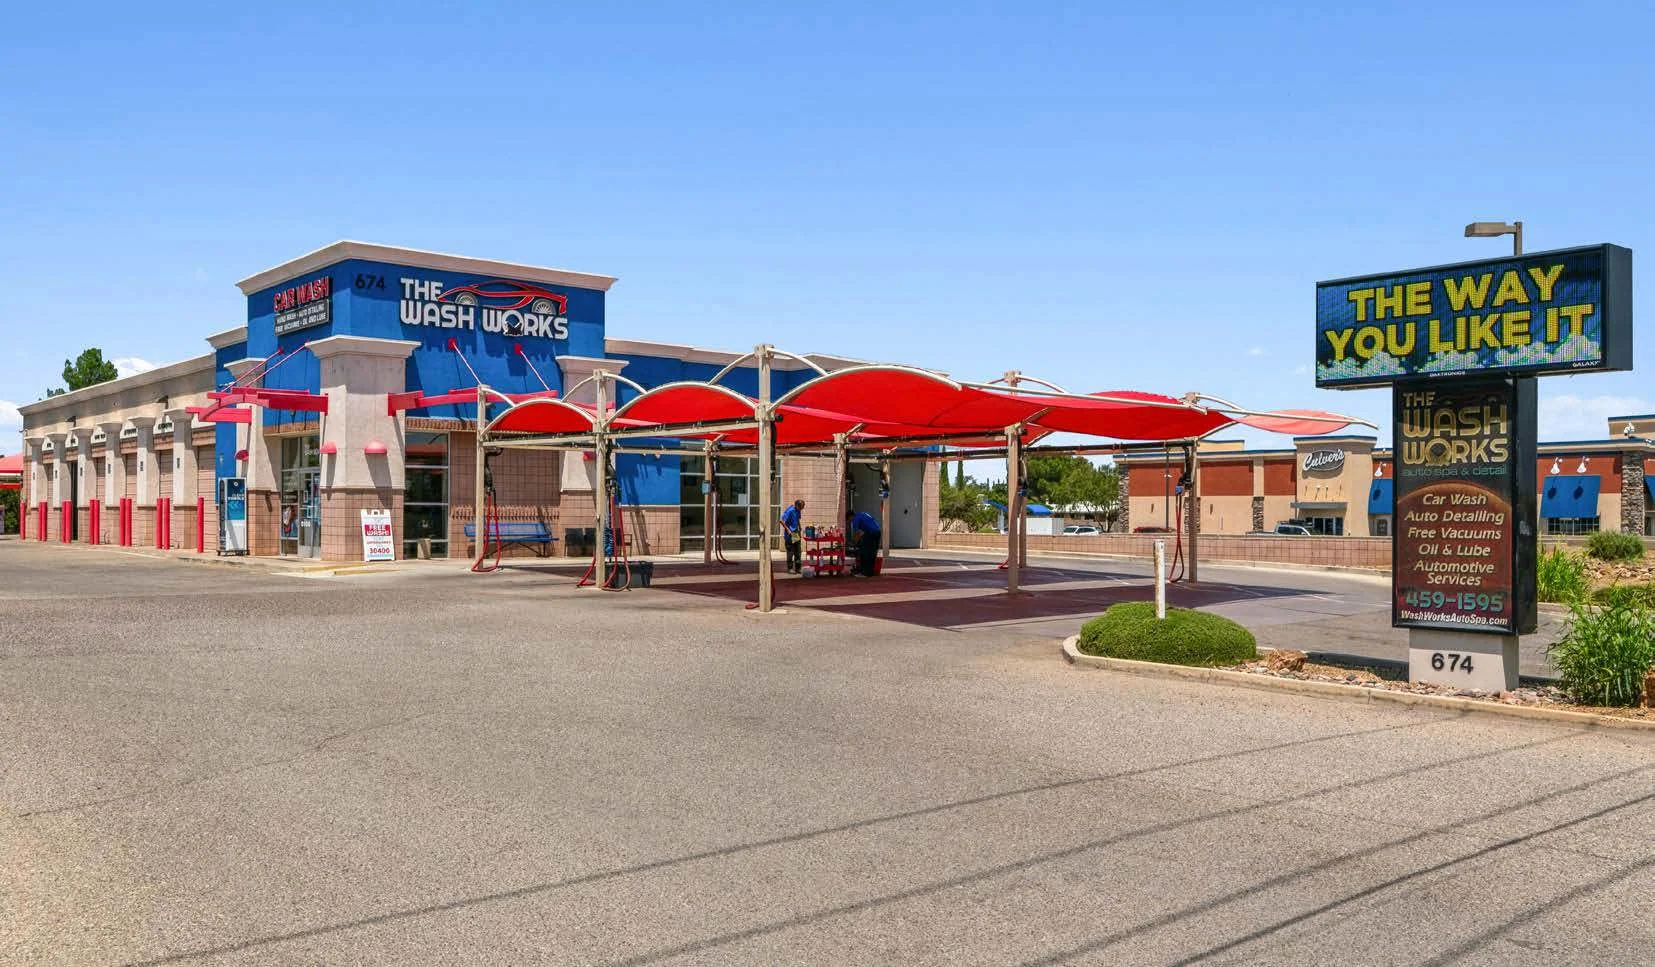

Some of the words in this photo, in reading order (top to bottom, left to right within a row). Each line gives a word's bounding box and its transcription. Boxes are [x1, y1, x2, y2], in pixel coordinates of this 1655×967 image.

[355, 273, 385, 290] 674
[400, 277, 443, 301] THE
[274, 288, 295, 312] CAR
[296, 276, 329, 304] WASH
[1348, 281, 1432, 322] THE
[1443, 264, 1565, 312] WAY
[400, 299, 475, 331] WASH
[482, 308, 569, 340] WORKS
[1325, 322, 1416, 361] YOU
[1429, 310, 1531, 353] LIKE
[1546, 303, 1594, 344] IT
[1572, 359, 1600, 368] GALAXY
[1402, 391, 1436, 407] THE
[1402, 404, 1508, 438] WASH
[1302, 448, 1345, 471] Culver's
[1402, 438, 1509, 466] WORKS
[1401, 467, 1431, 476] auto
[1432, 467, 1458, 478] spa
[1460, 466, 1470, 476] &
[1472, 464, 1507, 476] detail
[1422, 493, 1446, 505] Car
[1450, 493, 1487, 505] Wash
[1404, 510, 1438, 521] Auto
[1442, 510, 1505, 526] Detailing
[1407, 526, 1436, 539] Free
[1441, 527, 1502, 539] Vacuums
[1418, 543, 1439, 555] Oil
[1442, 543, 1452, 556] &
[1456, 544, 1491, 556] Lube
[1413, 559, 1495, 573] Automotive
[1426, 572, 1481, 586] Services
[1405, 591, 1504, 612] 459-1595
[1401, 610, 1508, 625] WashWorksAutoSpa.com
[1431, 652, 1474, 675] 674
